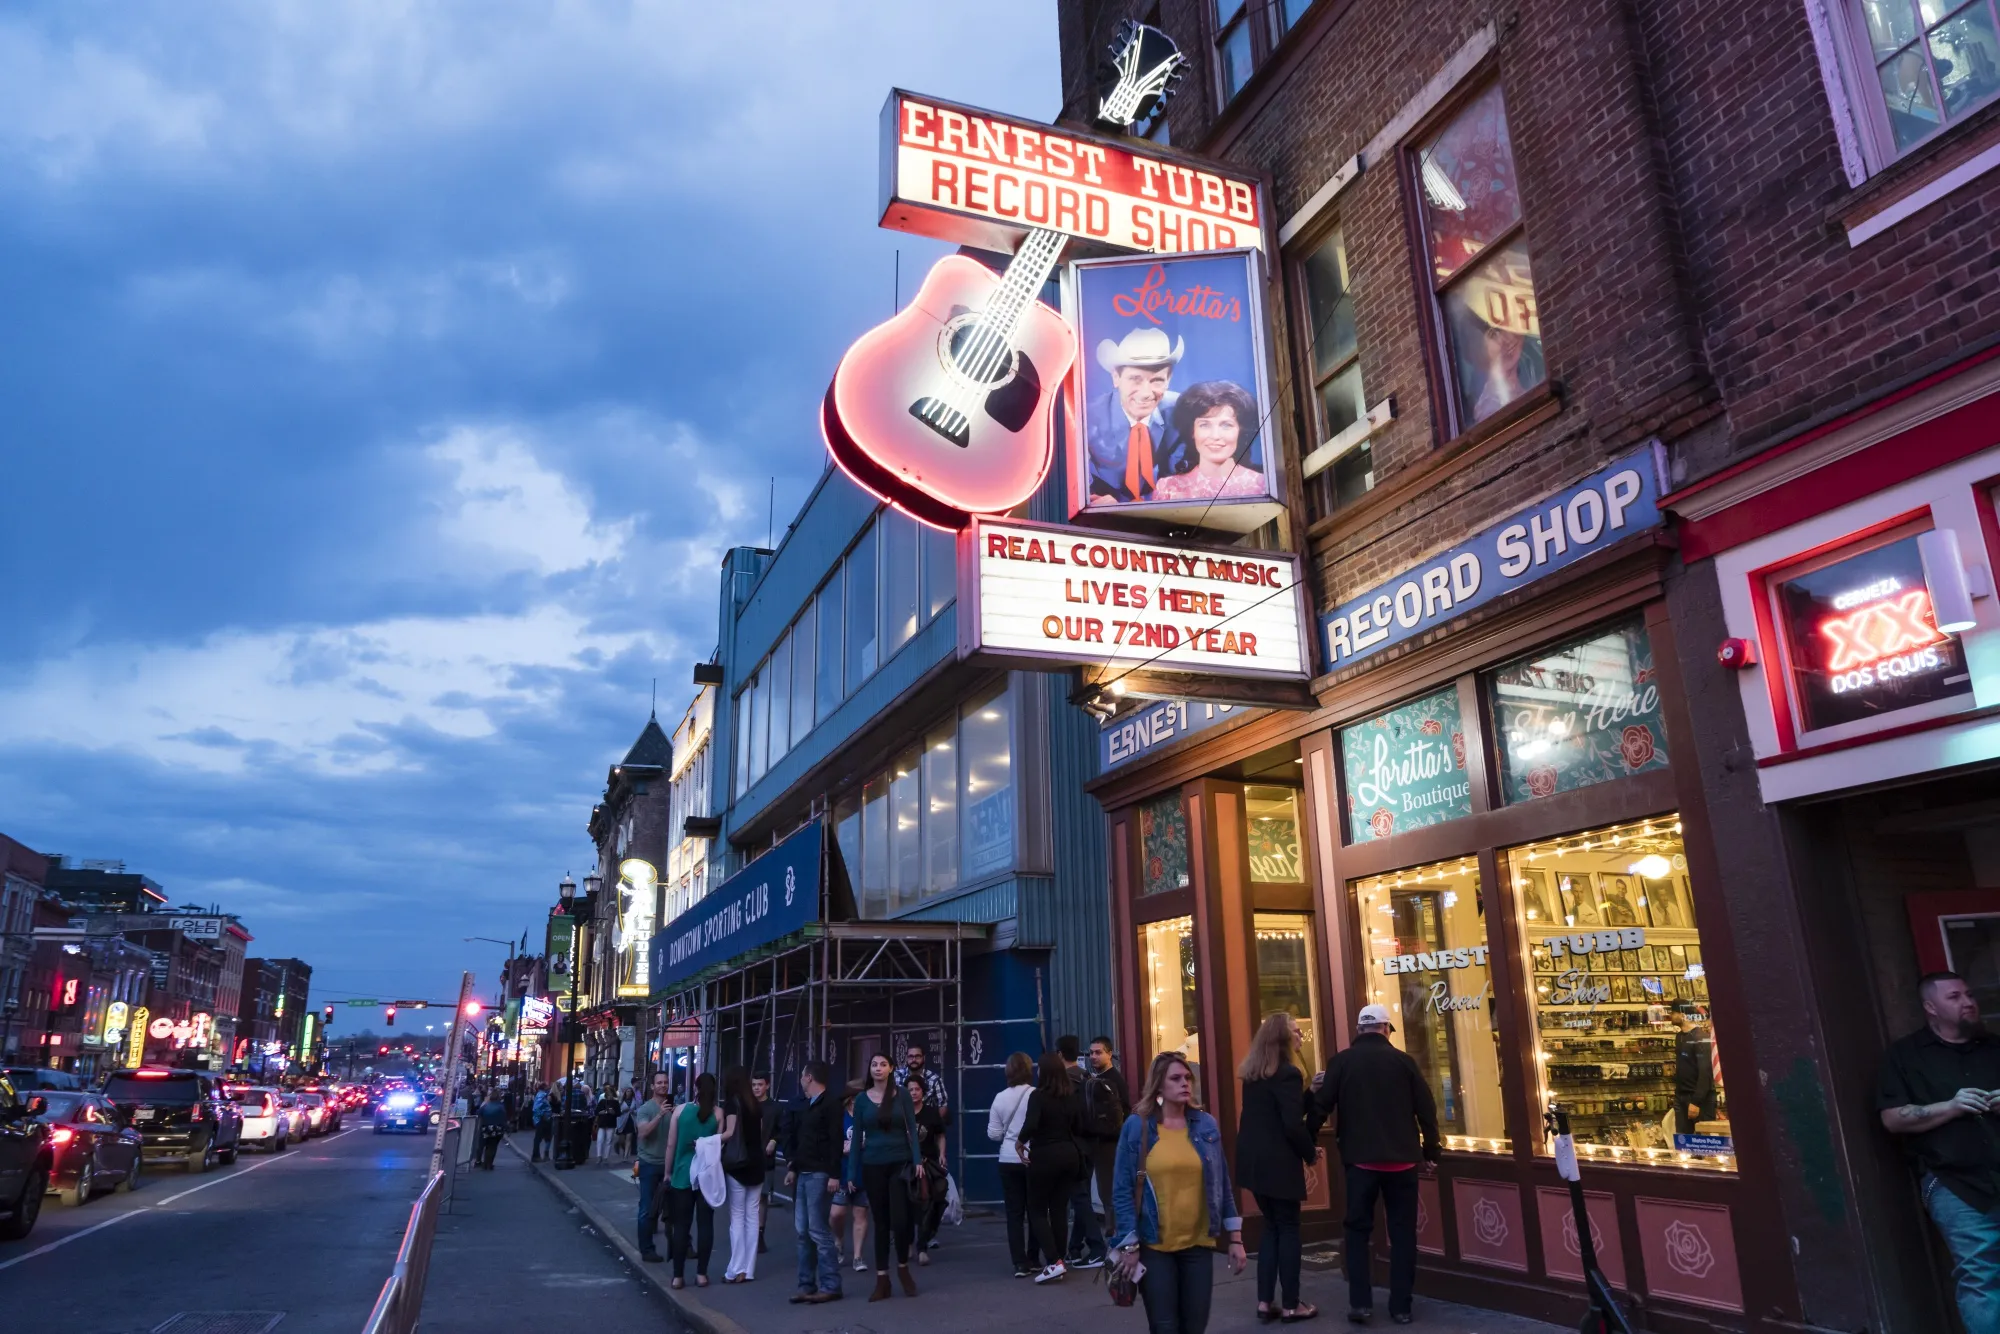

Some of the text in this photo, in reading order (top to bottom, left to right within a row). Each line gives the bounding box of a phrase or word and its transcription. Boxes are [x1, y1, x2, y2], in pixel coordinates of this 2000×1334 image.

[902, 99, 1255, 222] ERNEST TUBB
[931, 158, 1237, 253] RECORD SHOP
[1112, 263, 1242, 325] Loretta's
[987, 533, 1283, 589] REAL COUNTRY MUSIC
[1326, 468, 1643, 664] RECORD SHOP
[1065, 577, 1227, 617] LIVES HERE
[1833, 577, 1902, 610] CERVEZA
[1042, 614, 1258, 657] OUR 72ND YEAR
[1821, 590, 1938, 672] XX
[1831, 647, 1940, 695] DOS EQUIS
[1108, 700, 1189, 765] ERNEST
[1578, 680, 1660, 734] Here
[1357, 732, 1455, 807] Loretta's
[1401, 780, 1472, 813] Boutique
[552, 934, 571, 942] OPEN
[669, 923, 702, 968] DOWNTOWN
[704, 899, 742, 948] SPORTING
[745, 882, 770, 925] CLUB
[1382, 926, 1646, 976] ERNEST TUBB
[1425, 980, 1490, 1016] Record
[1550, 967, 1611, 1013] Shop
[1706, 1137, 1722, 1145] Police
